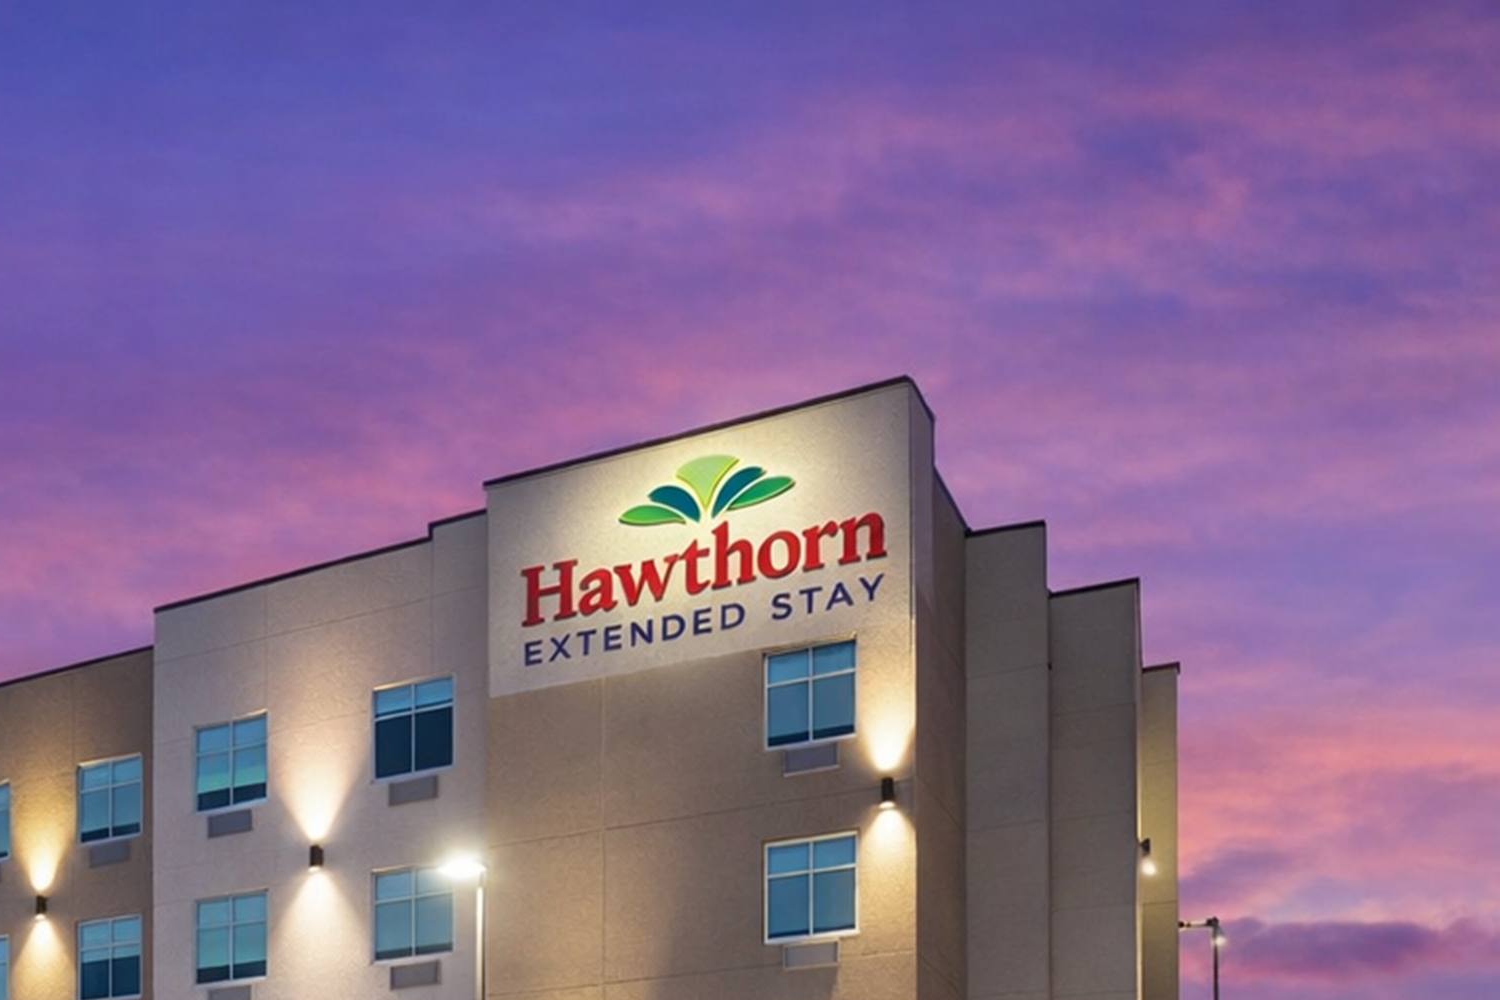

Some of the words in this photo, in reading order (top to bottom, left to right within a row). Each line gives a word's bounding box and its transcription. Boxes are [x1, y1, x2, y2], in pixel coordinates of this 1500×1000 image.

[520, 511, 888, 627] Hawthorn
[524, 603, 746, 667] EXTENDED
[771, 573, 884, 621] STAY
